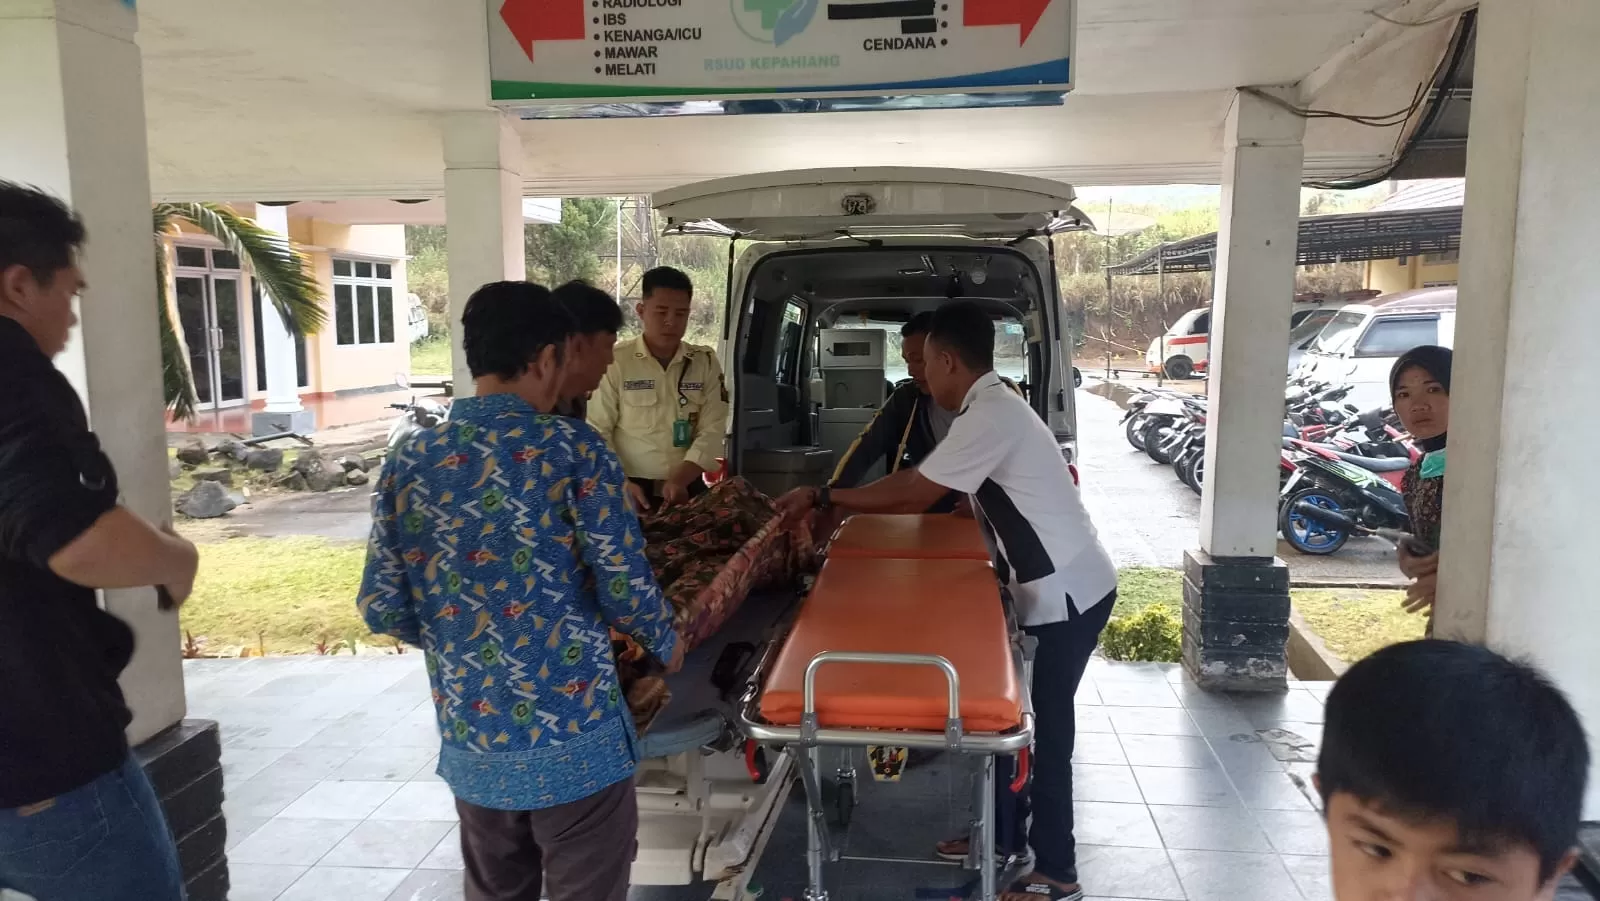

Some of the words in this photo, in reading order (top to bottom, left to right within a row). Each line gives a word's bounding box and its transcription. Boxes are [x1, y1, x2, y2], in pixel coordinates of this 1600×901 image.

[603, 13, 626, 25] IBS
[604, 27, 702, 42] KENANGA/ICU
[863, 37, 936, 51] CENDANA
[605, 46, 658, 59] MAWAR
[703, 57, 745, 71] RSUD
[750, 54, 841, 70] KEPAHIANG
[605, 63, 656, 76] MELATI
